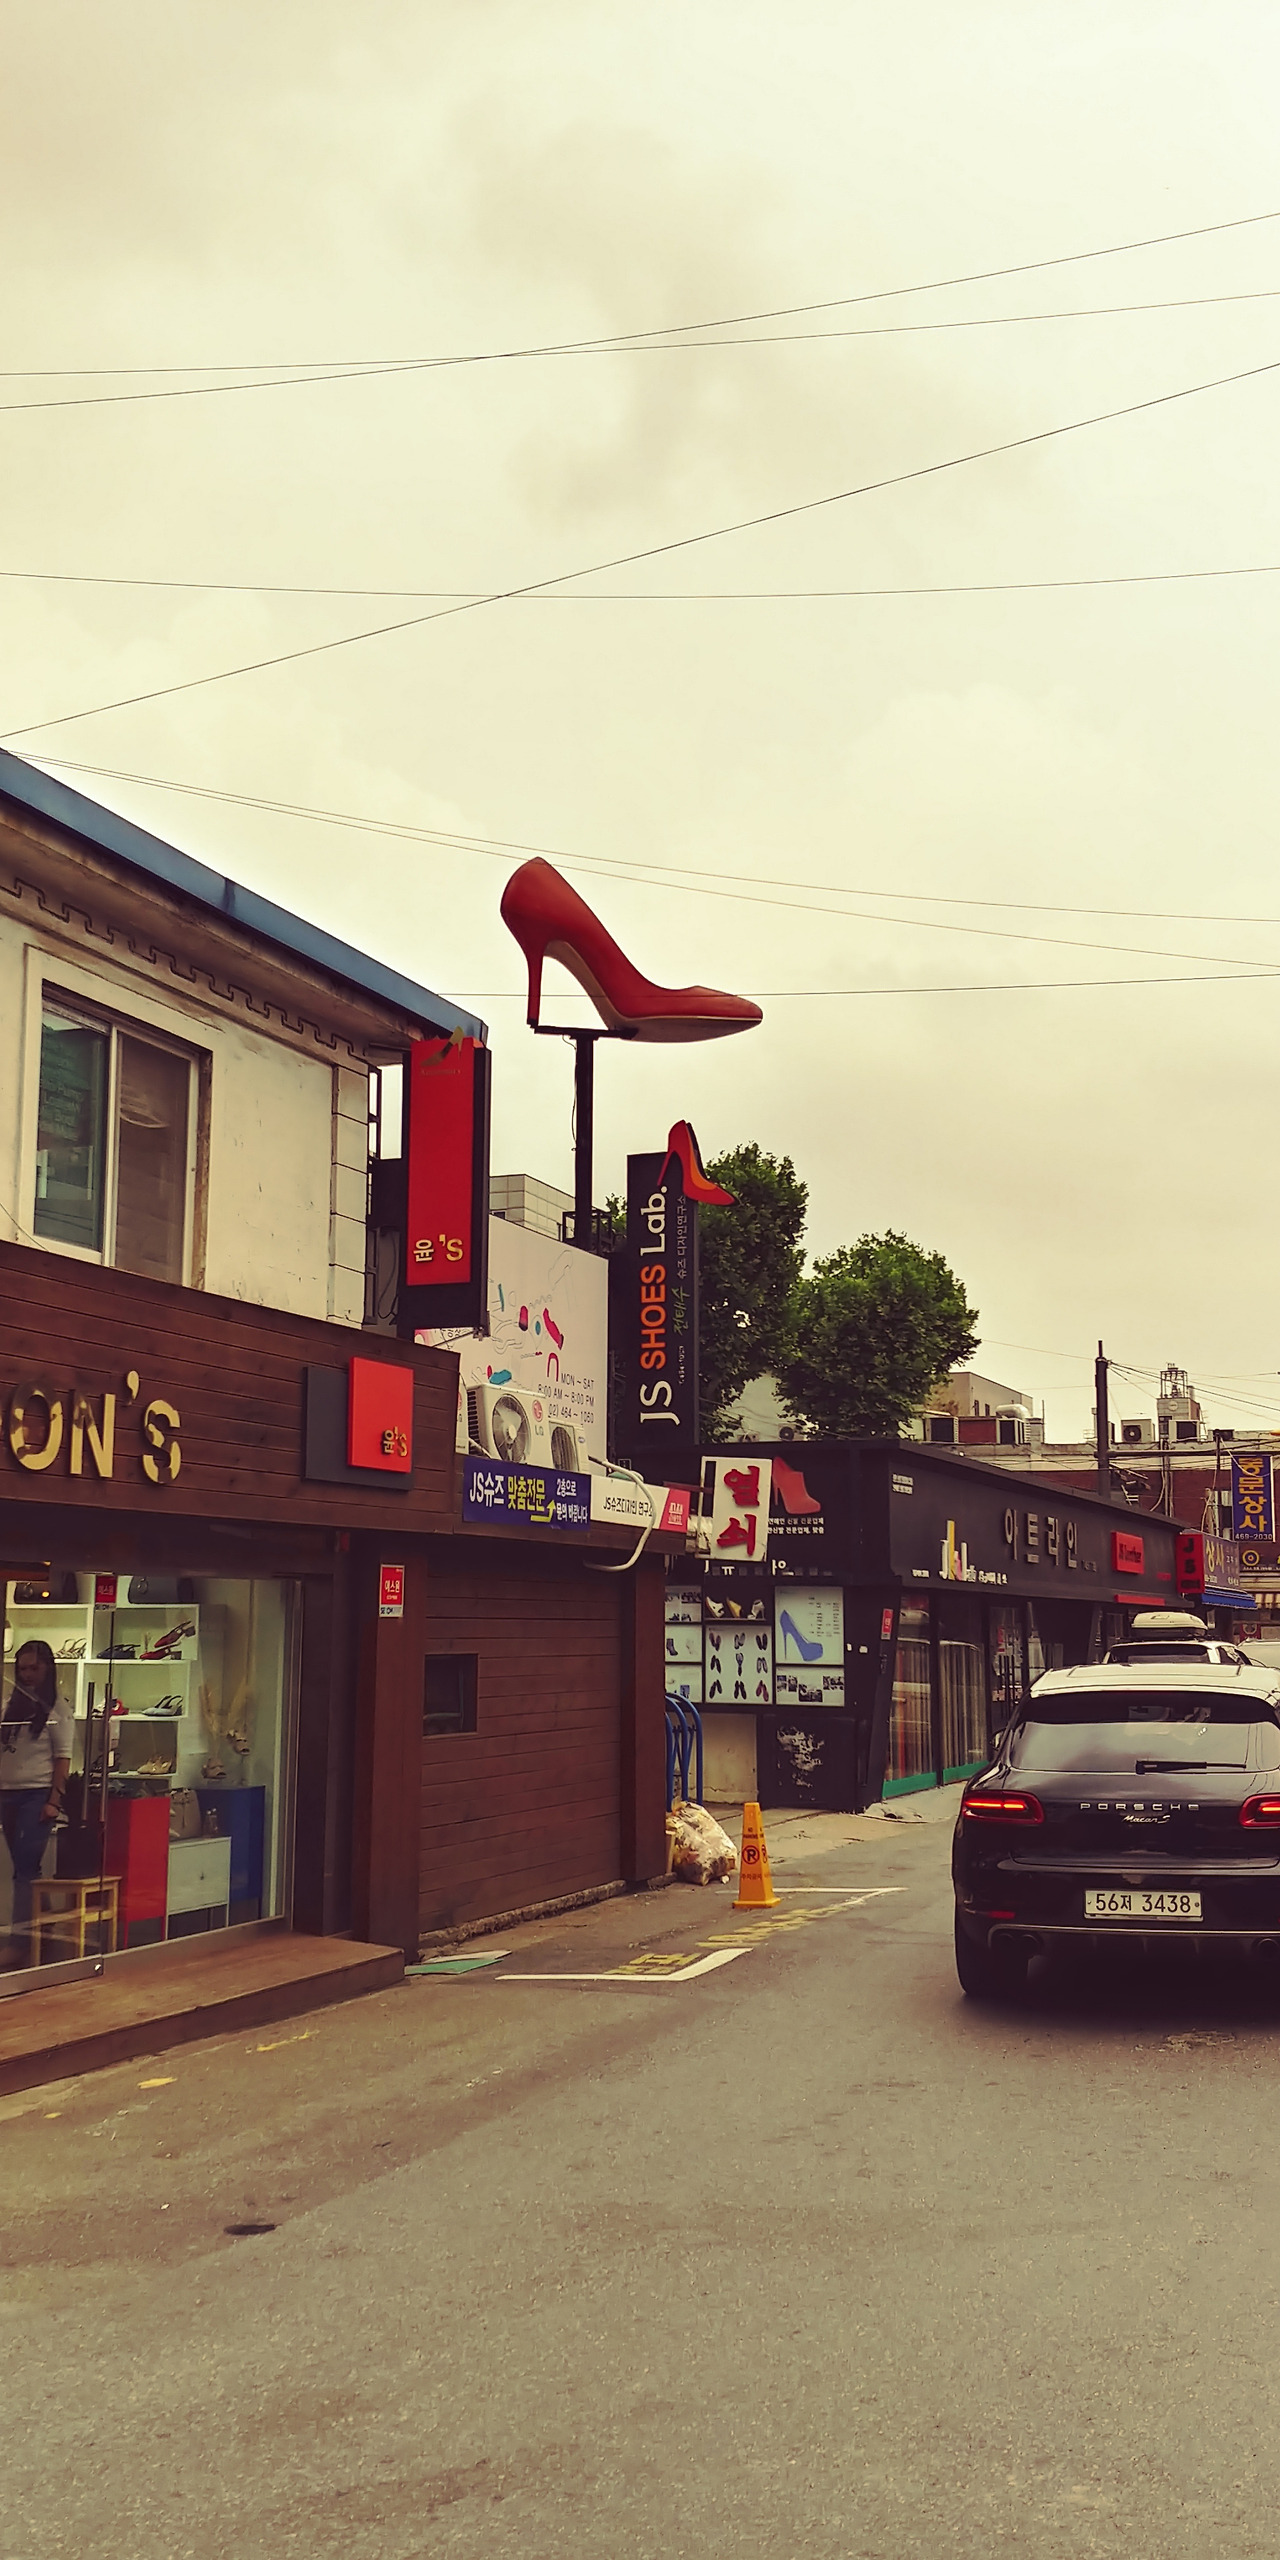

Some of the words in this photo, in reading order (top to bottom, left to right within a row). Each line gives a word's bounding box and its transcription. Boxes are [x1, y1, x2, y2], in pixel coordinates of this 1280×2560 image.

[640, 1185, 668, 1257] Lab.
[413, 1234, 463, 1262] 윤'S
[640, 1264, 666, 1370] SHOES
[561, 1373, 575, 1386] MON
[583, 1378, 594, 1390] SAT
[553, 1388, 563, 1399] AM
[586, 1395, 594, 1407] PM
[640, 1380, 681, 1426] JS
[0, 1370, 181, 1484] ON'S
[535, 1425, 544, 1436] LG
[469, 1472, 504, 1508] JS슈즈
[507, 1475, 546, 1513] 맞춤전문
[556, 1478, 577, 1498] 2층으로
[556, 1502, 568, 1522] 문의
[568, 1504, 588, 1524] 바랍니다
[716, 1465, 760, 1557] 열쇠
[1004, 1507, 1078, 1569] 아트라인
[1080, 1802, 1199, 1811] PORSCHE
[1122, 1815, 1158, 1823] Macan
[1095, 1893, 1132, 1912] 56저
[1142, 1894, 1191, 1913] 3438
